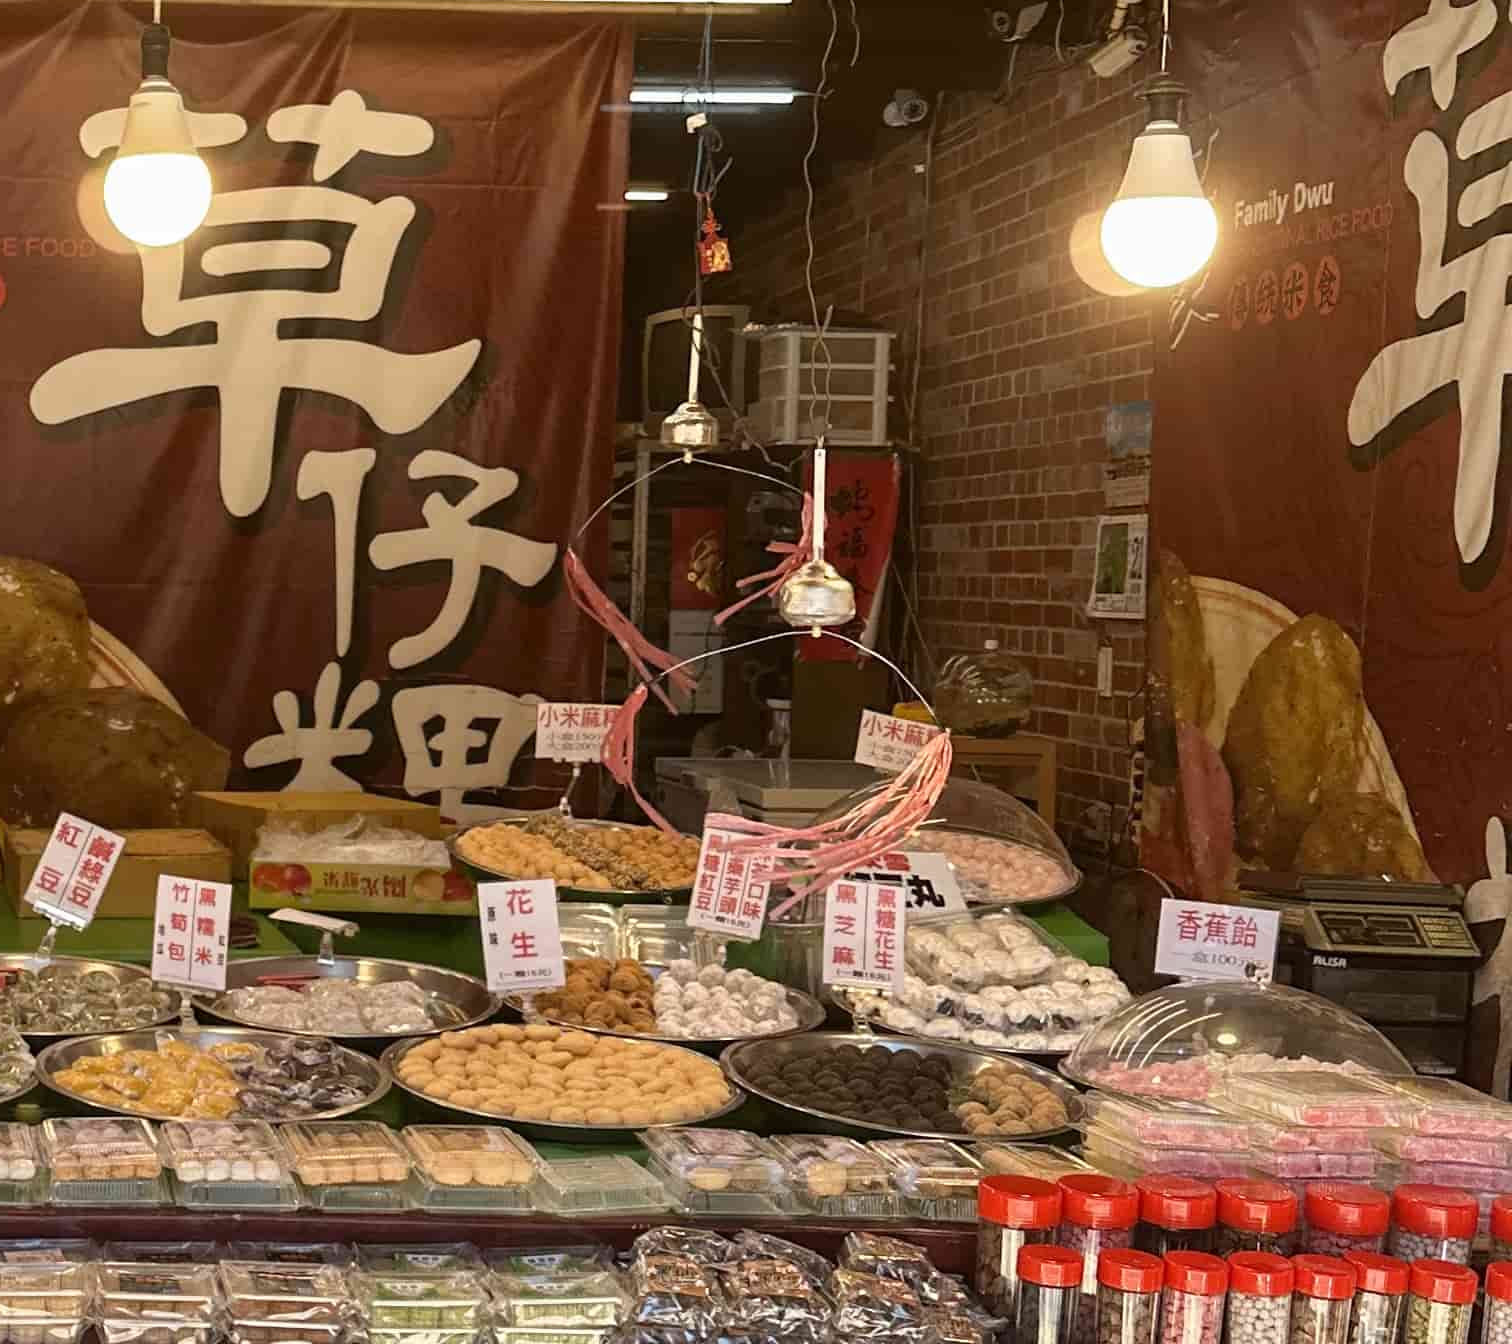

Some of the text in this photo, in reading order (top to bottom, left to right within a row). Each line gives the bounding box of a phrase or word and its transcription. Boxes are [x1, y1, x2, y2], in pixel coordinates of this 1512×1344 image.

[1233, 181, 1335, 231] Family Dwu
[35, 821, 84, 894] 紅豆
[505, 889, 539, 959] 花生
[832, 884, 856, 965] 黑芝麻
[874, 888, 896, 970] 黑糖花生
[1177, 910, 1258, 948] 香蕉飴
